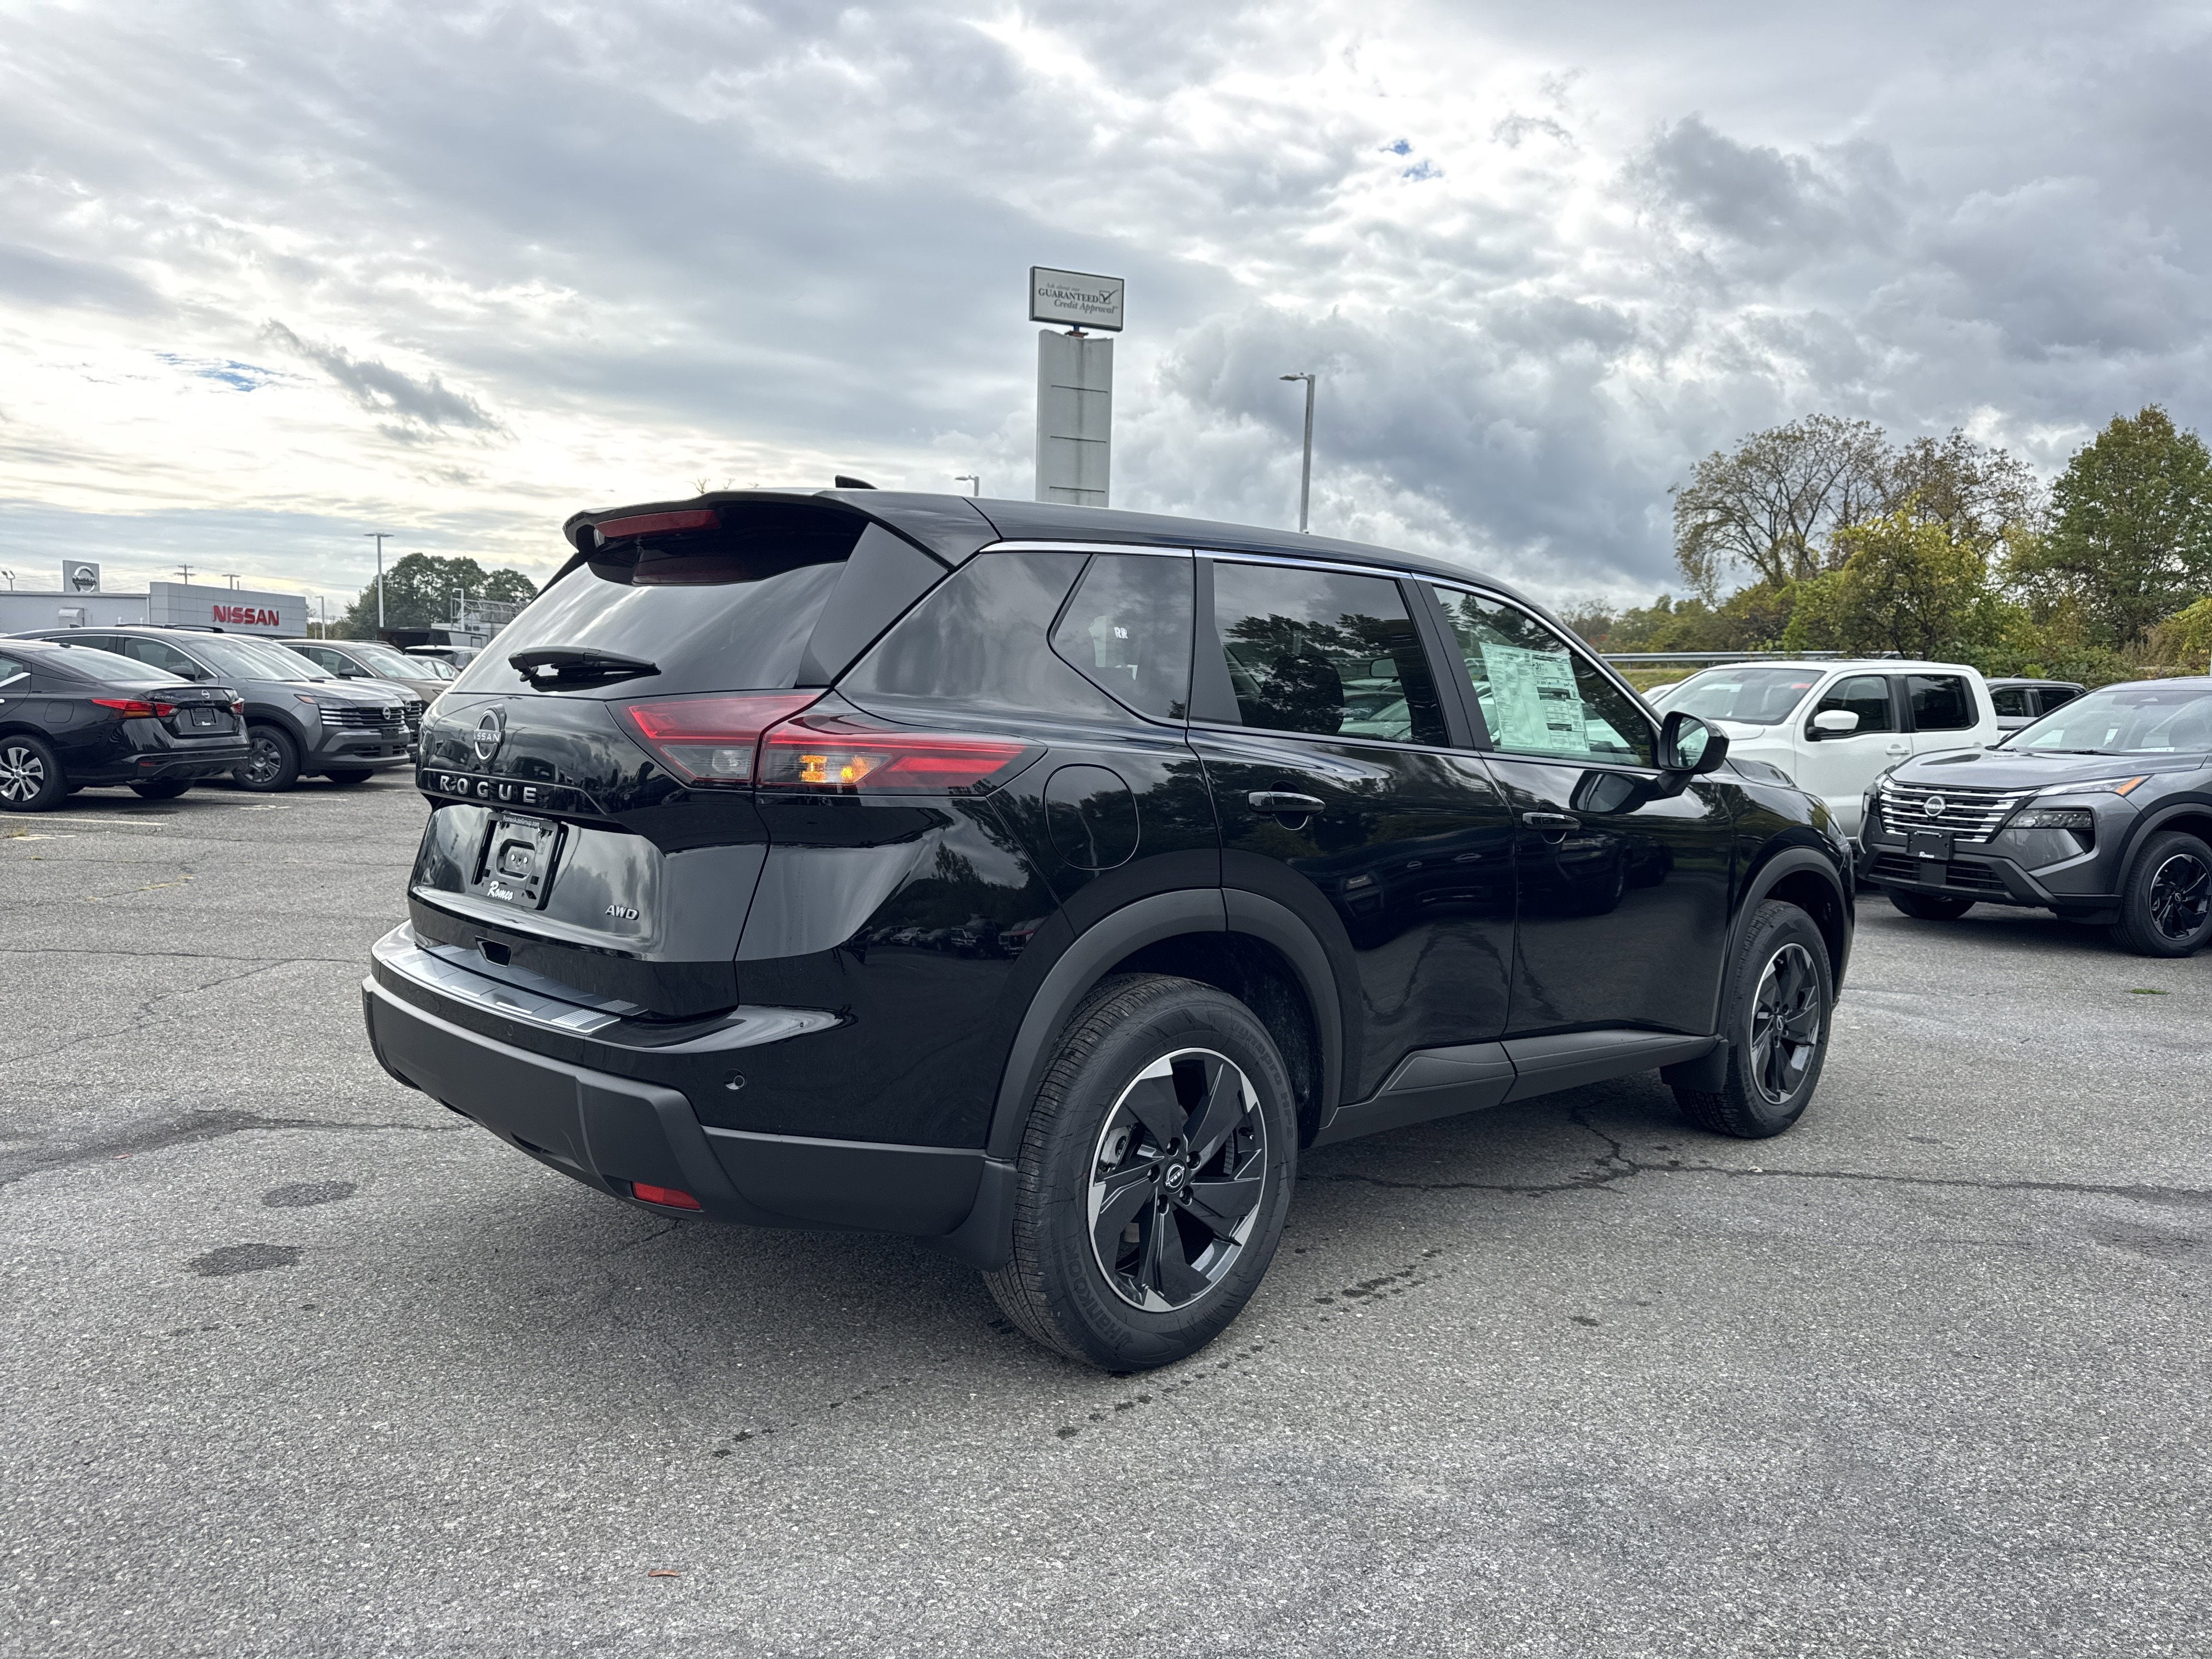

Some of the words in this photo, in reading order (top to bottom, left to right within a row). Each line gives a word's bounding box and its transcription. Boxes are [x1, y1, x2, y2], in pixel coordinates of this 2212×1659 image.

[1038, 288, 1098, 303] GUARANTEED
[1054, 298, 1078, 309] Credit
[1079, 302, 1115, 314] Approval
[212, 605, 279, 627] NISSAN
[439, 775, 537, 804] ROGUE
[487, 881, 514, 901] Romeo
[605, 905, 639, 921] AWD
